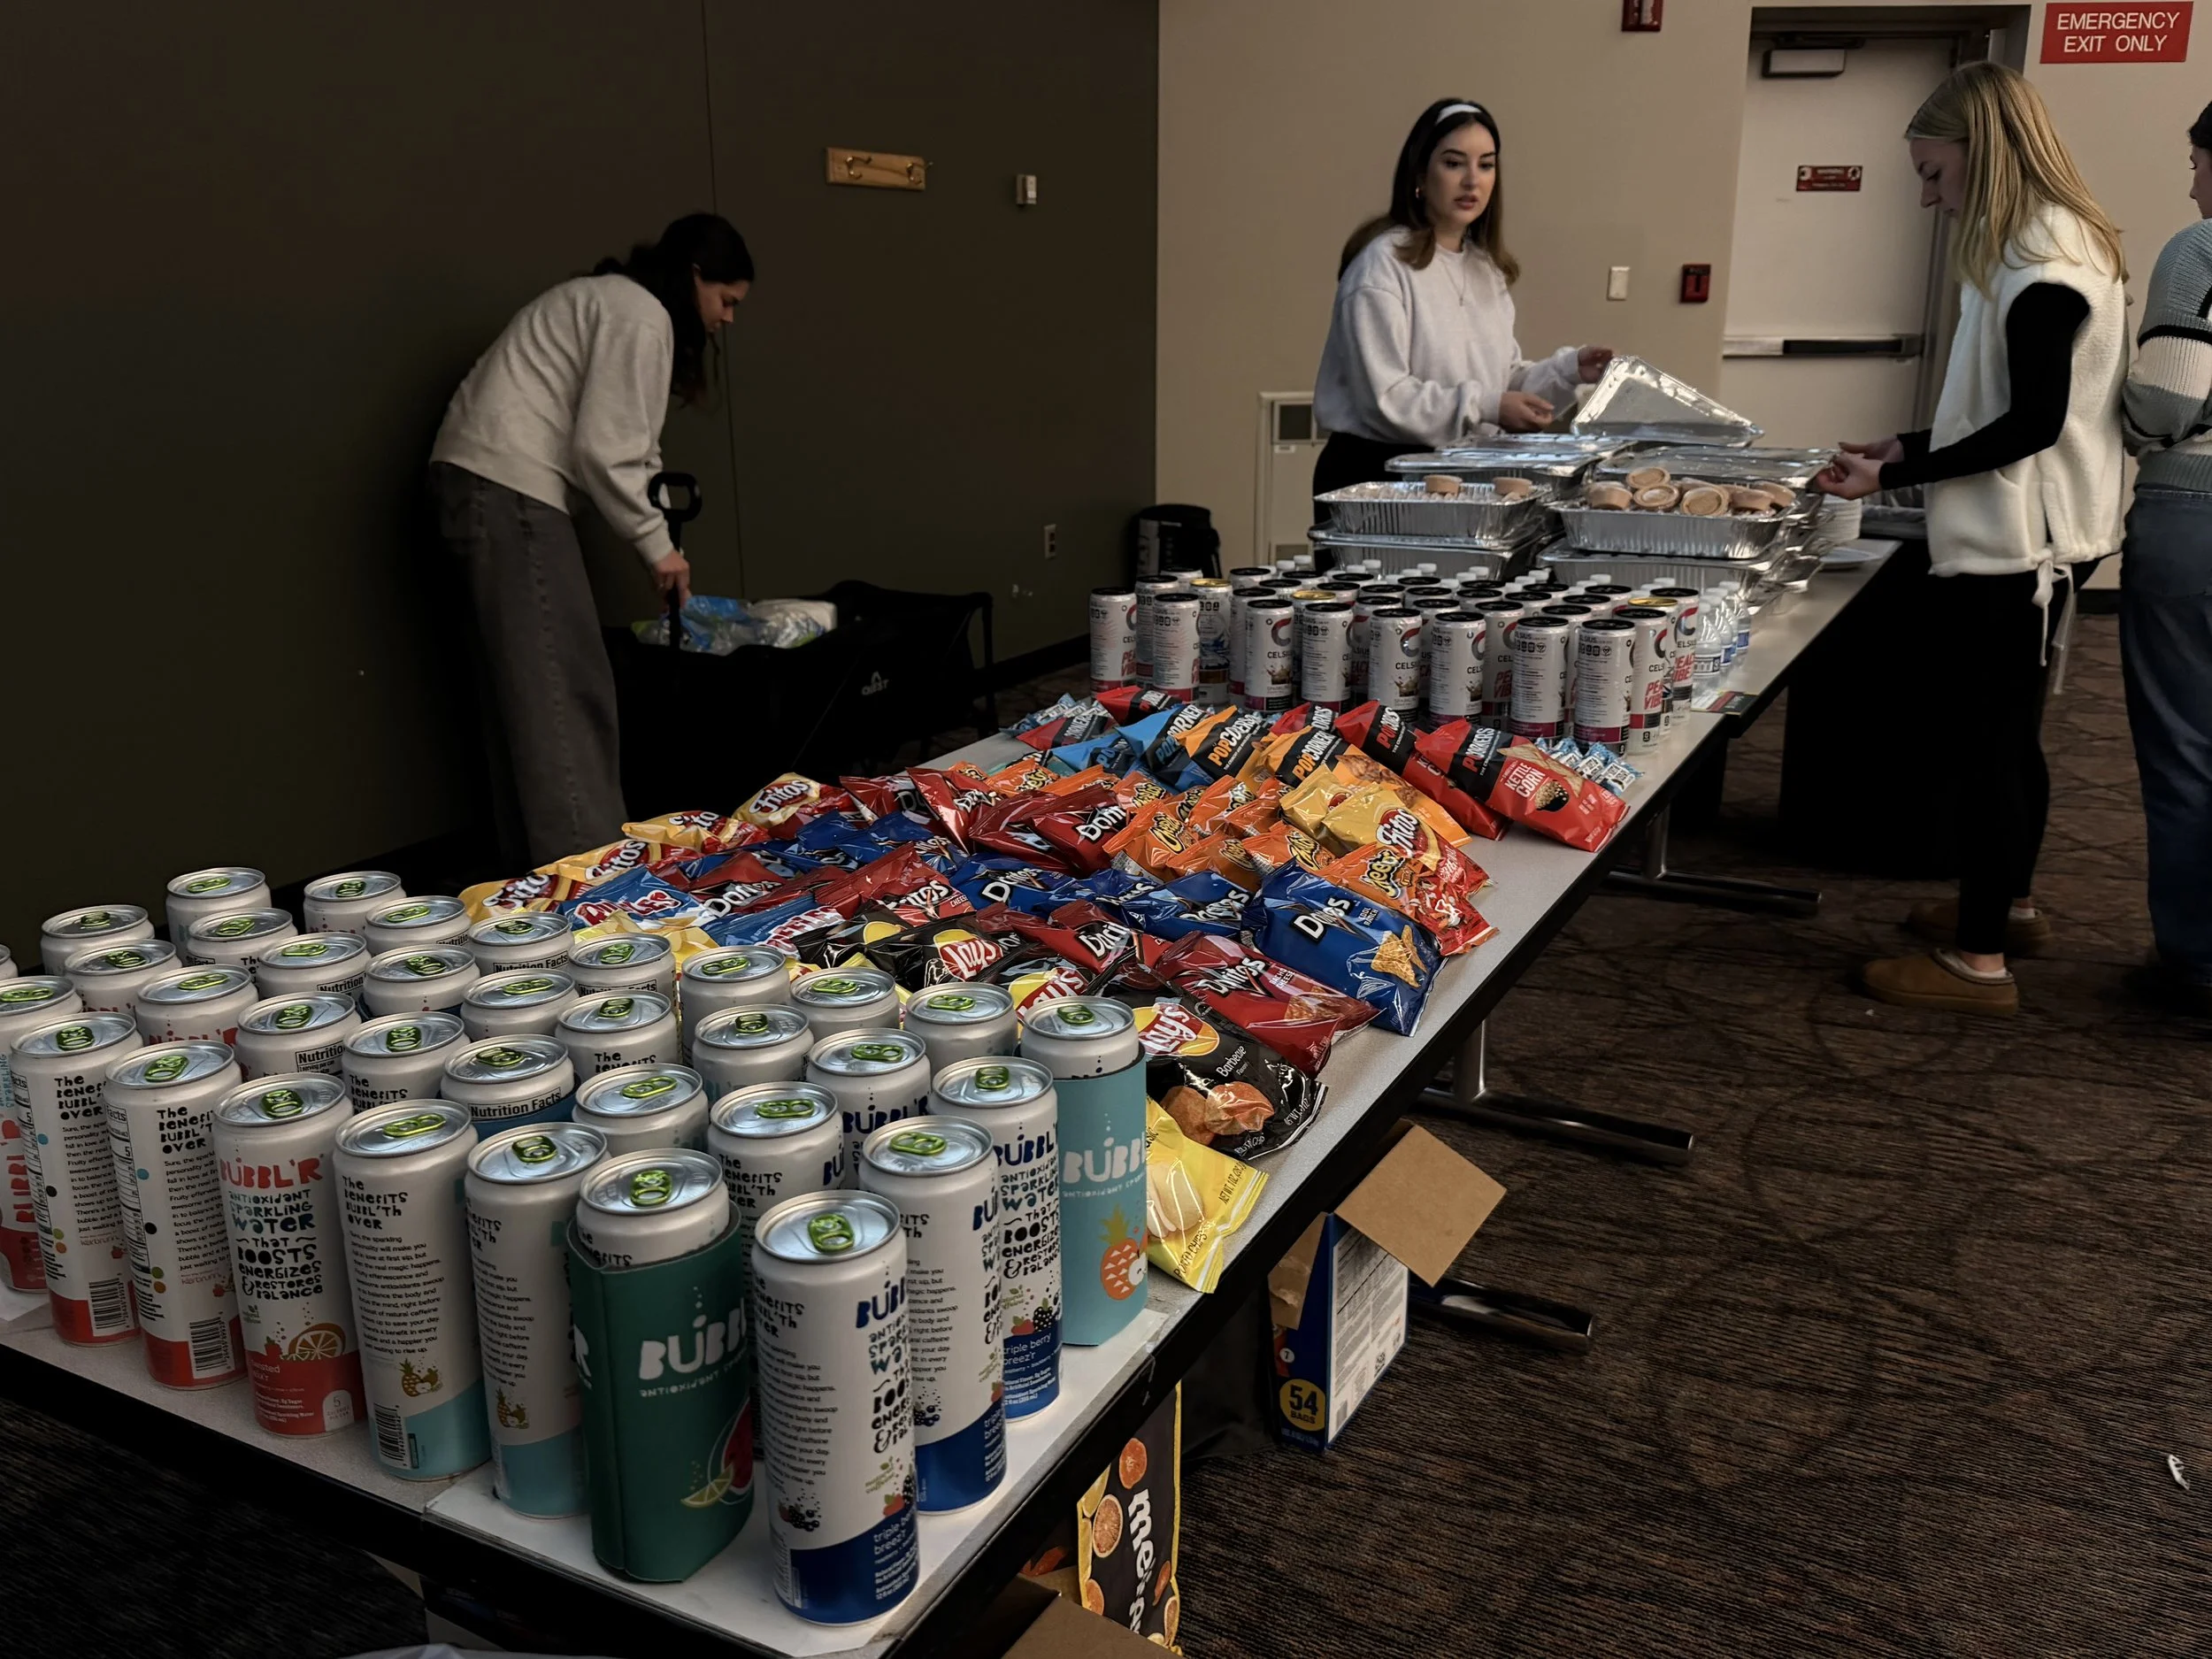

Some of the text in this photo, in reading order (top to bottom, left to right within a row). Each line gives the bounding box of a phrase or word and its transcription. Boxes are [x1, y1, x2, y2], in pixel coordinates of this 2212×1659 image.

[2057, 12, 2180, 30] EMERGENCY
[2063, 35, 2168, 53] EXIT ONLY
[1504, 762, 1532, 792] KETTLE
[1516, 767, 1547, 797] CORN
[749, 780, 810, 815] Fritos
[545, 954, 569, 968] Facts
[319, 975, 364, 992] Nutrition
[595, 1052, 621, 1063] The
[1216, 1045, 1248, 1078] Barbecue
[54, 1075, 85, 1087] The
[349, 1074, 369, 1087] The
[157, 1106, 188, 1119] The
[470, 1091, 562, 1118] Nutrition Facts
[125, 1146, 130, 1157] 5
[719, 1153, 741, 1169] The
[342, 1175, 365, 1190] The
[237, 1243, 318, 1265] BOOSTS
[1003, 1257, 1022, 1279] &
[1030, 1333, 1052, 1349] berry
[333, 1396, 342, 1409] 5
[1288, 1384, 1318, 1416] 54
[1290, 1409, 1317, 1425] BAGS
